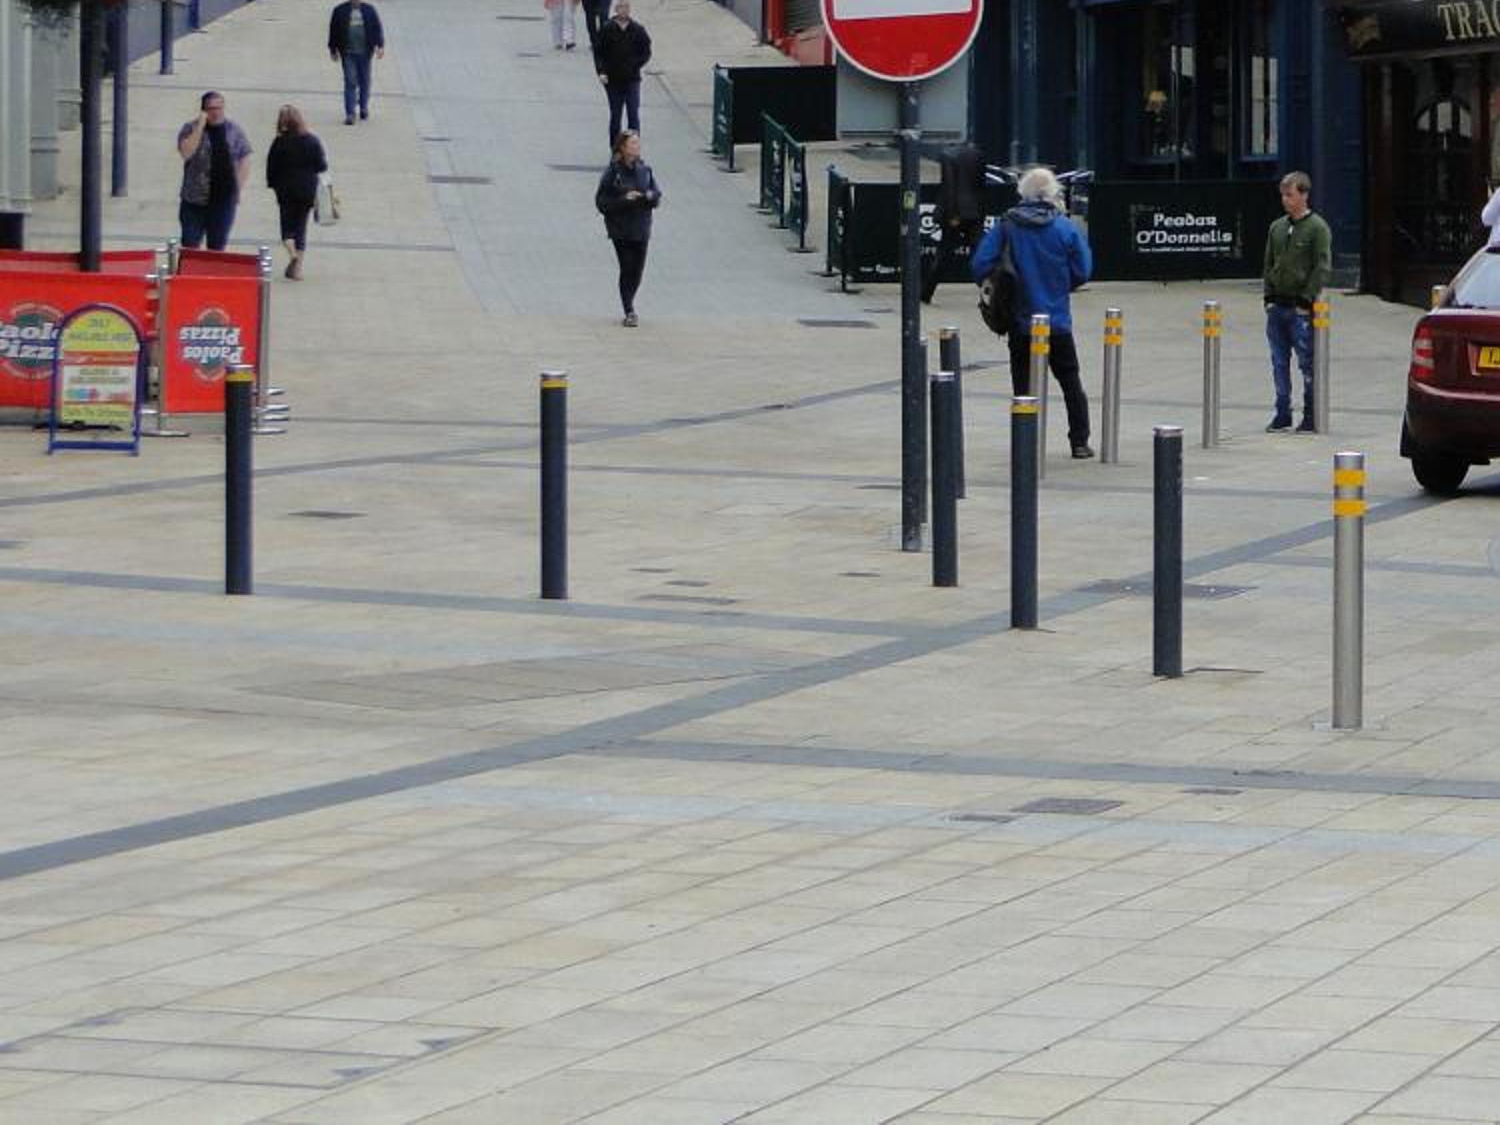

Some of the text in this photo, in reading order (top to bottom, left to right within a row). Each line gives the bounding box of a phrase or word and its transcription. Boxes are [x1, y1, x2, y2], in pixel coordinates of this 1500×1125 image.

[1153, 212, 1217, 227] Peadar
[1136, 230, 1233, 245] O'Donnells
[180, 326, 241, 346] Pizzas
